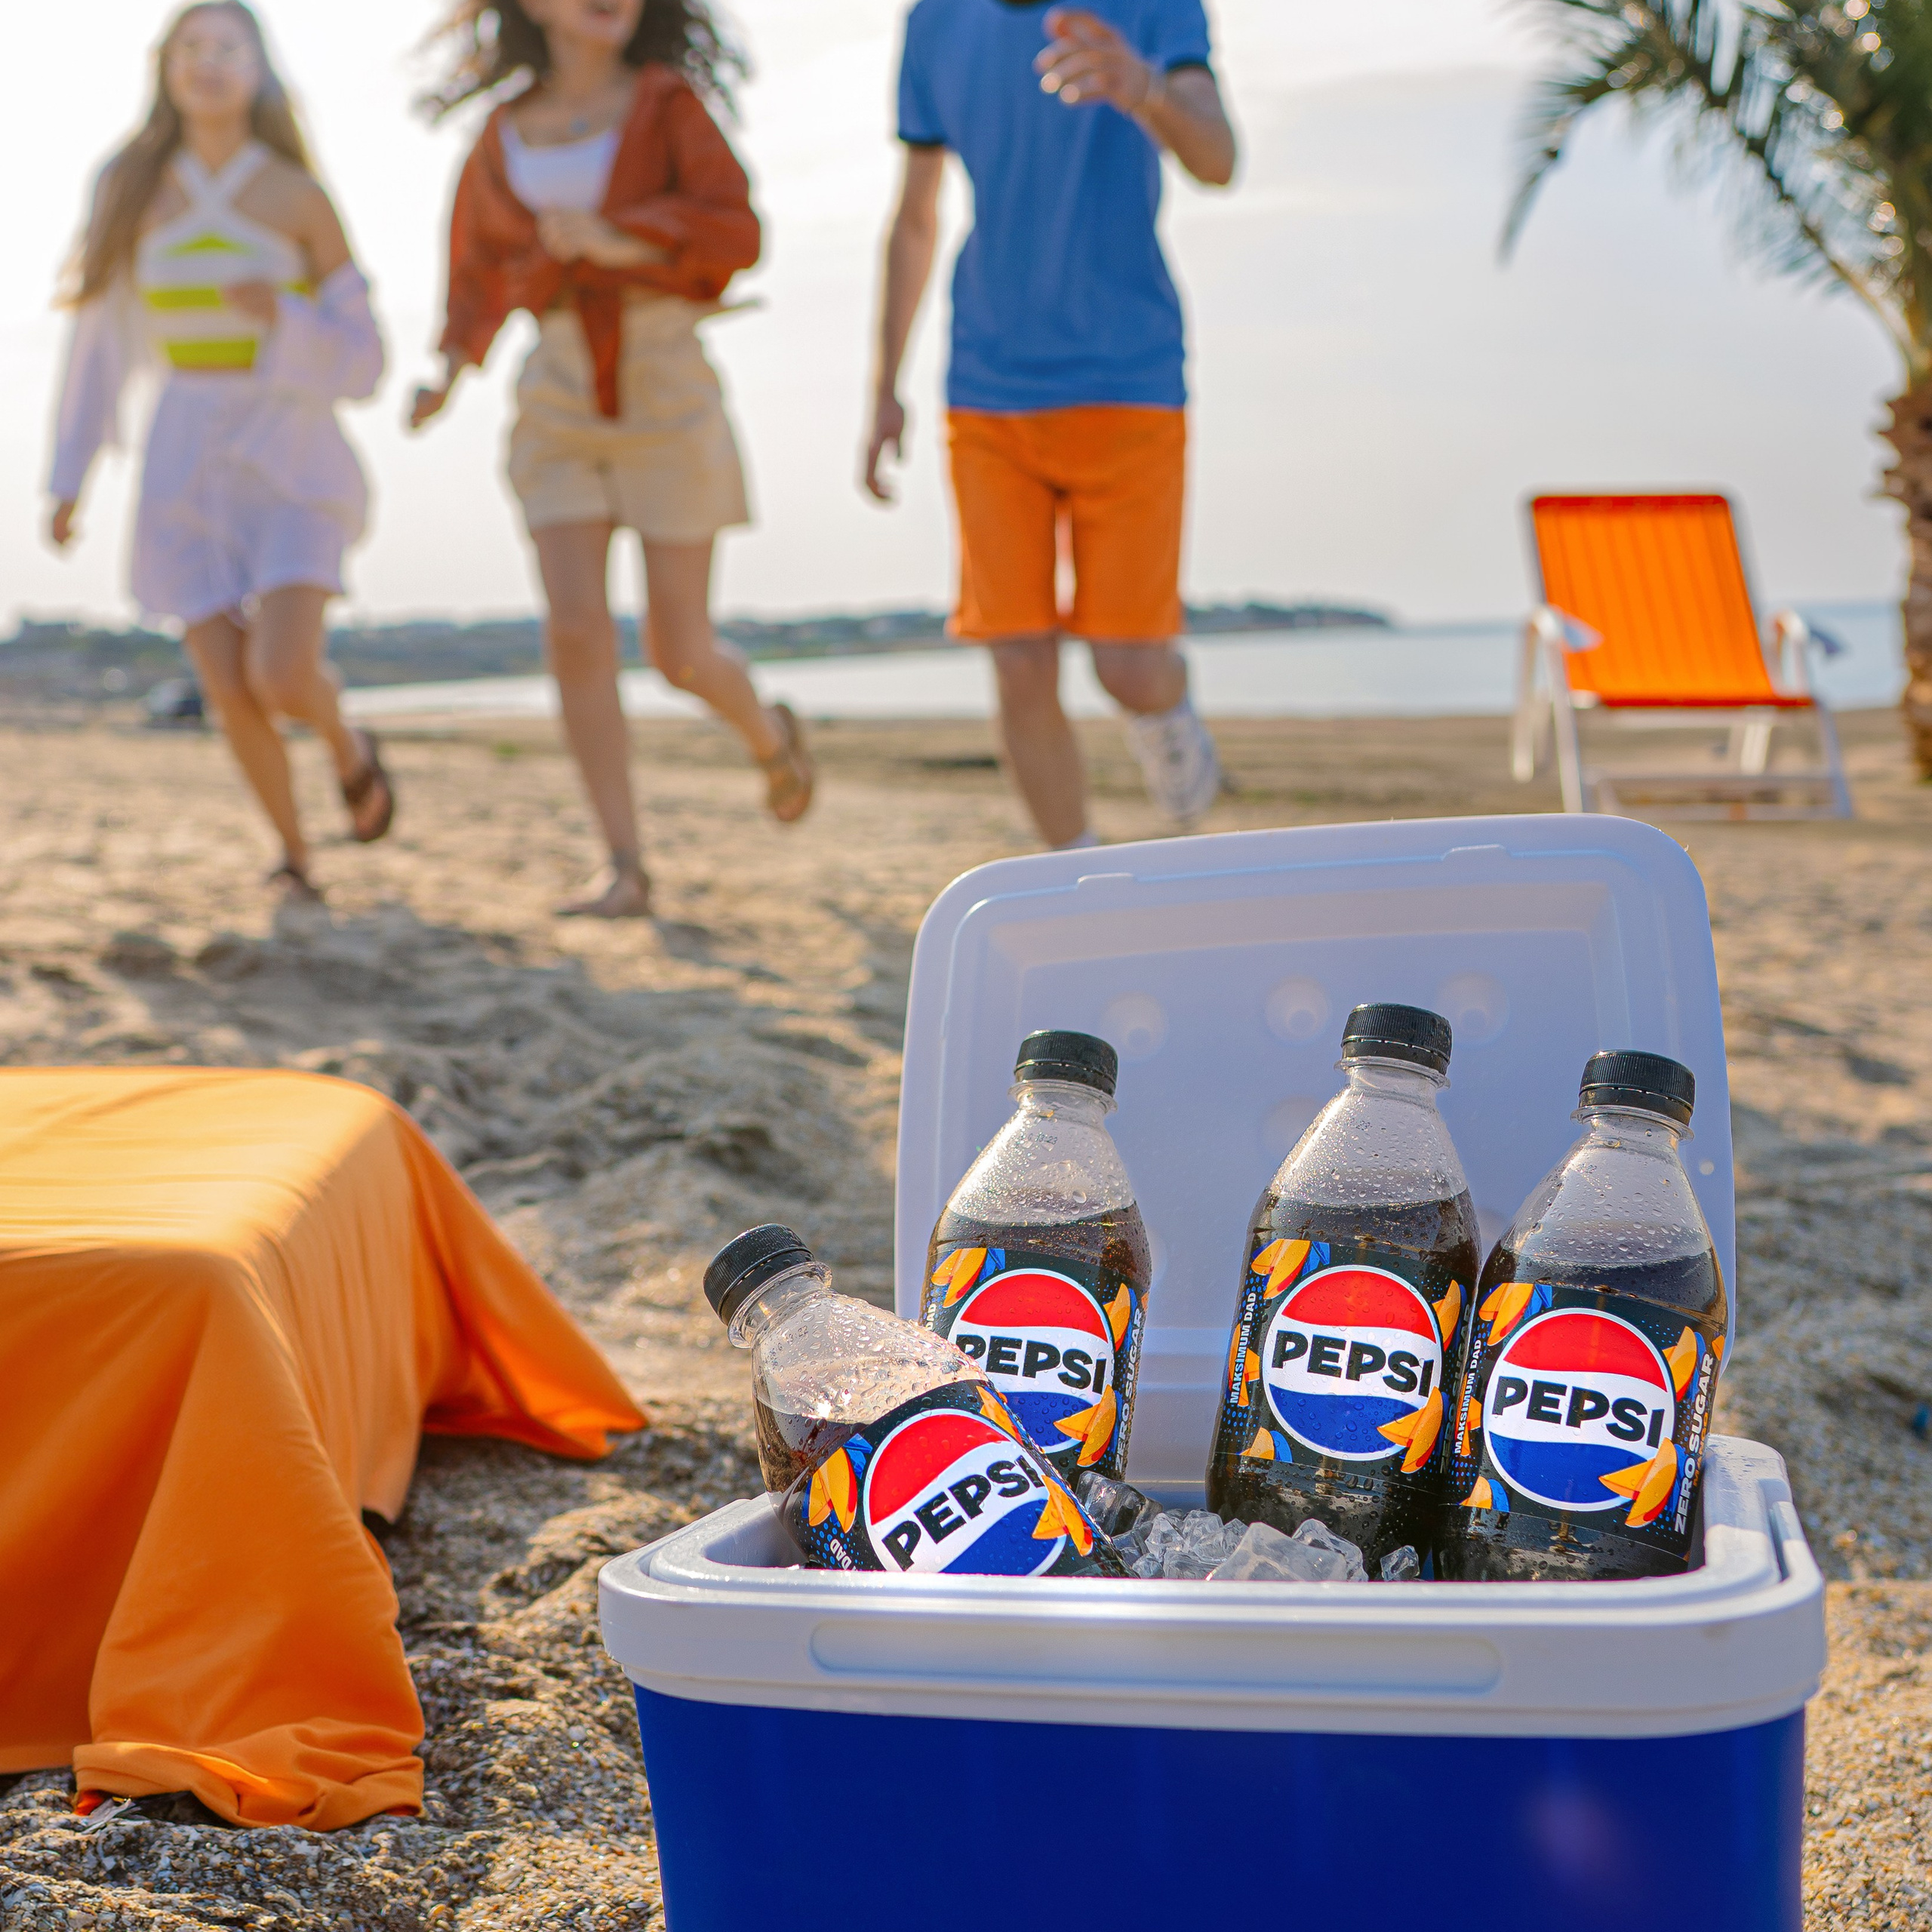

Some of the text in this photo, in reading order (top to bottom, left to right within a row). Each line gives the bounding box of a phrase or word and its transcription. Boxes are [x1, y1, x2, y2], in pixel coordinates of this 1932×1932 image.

[926, 1303, 937, 1331] DAD
[1243, 1292, 1256, 1321] DAD
[955, 1334, 1107, 1395] PEPSI
[1272, 1330, 1434, 1398] PEPSI
[1469, 1340, 1481, 1369] DAD
[1115, 1403, 1130, 1472] ZERO
[1125, 1308, 1143, 1397] SUGAR
[1492, 1376, 1665, 1449] PEPSI
[1675, 1353, 1714, 1535] ZERO SUGAR
[881, 1455, 1045, 1571] PEPSI
[830, 1539, 852, 1571] DAD
